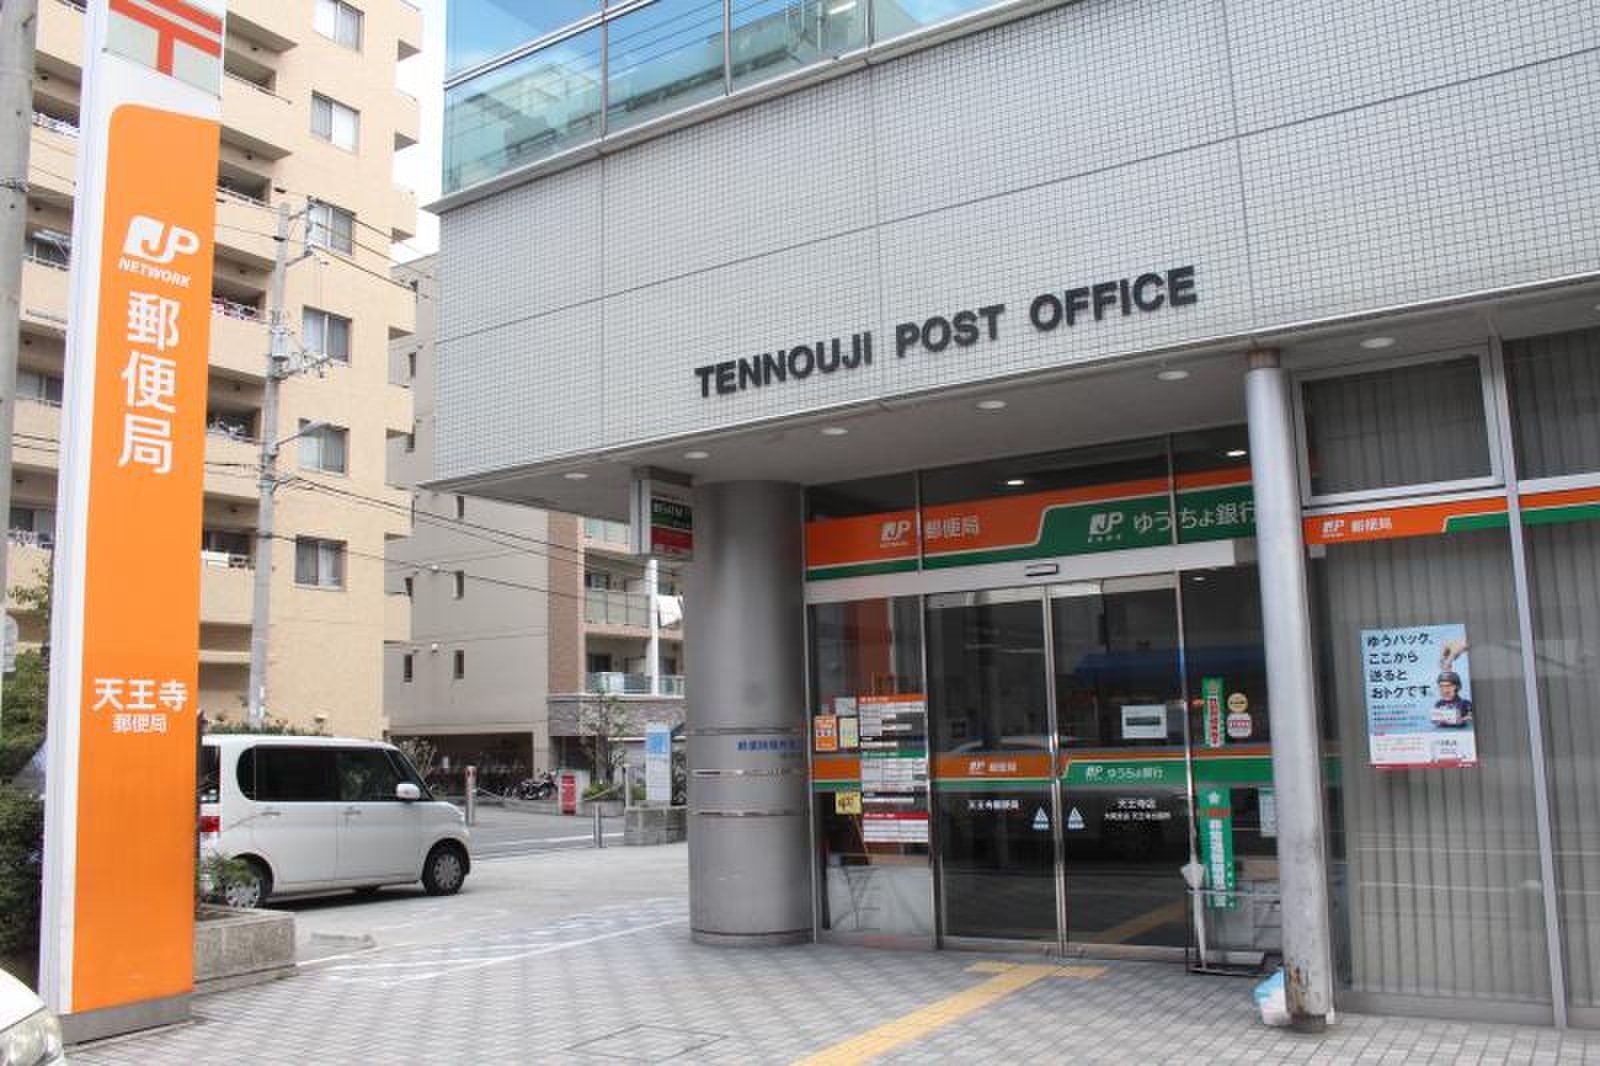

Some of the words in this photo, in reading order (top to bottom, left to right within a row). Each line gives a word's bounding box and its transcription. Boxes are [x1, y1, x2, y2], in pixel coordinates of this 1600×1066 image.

[118, 256, 192, 288] NETWORK
[694, 331, 873, 397] TENNOUJI
[896, 304, 1005, 358] POST
[1030, 265, 1198, 332] OFFICE
[118, 291, 180, 474] 郵便局
[925, 515, 980, 540] 郵便局
[1351, 517, 1392, 533] 郵便局
[1369, 650, 1419, 665] ここから
[1370, 669, 1408, 682] 送ると
[92, 678, 188, 712] 天王寺
[111, 713, 167, 733] 郵便局
